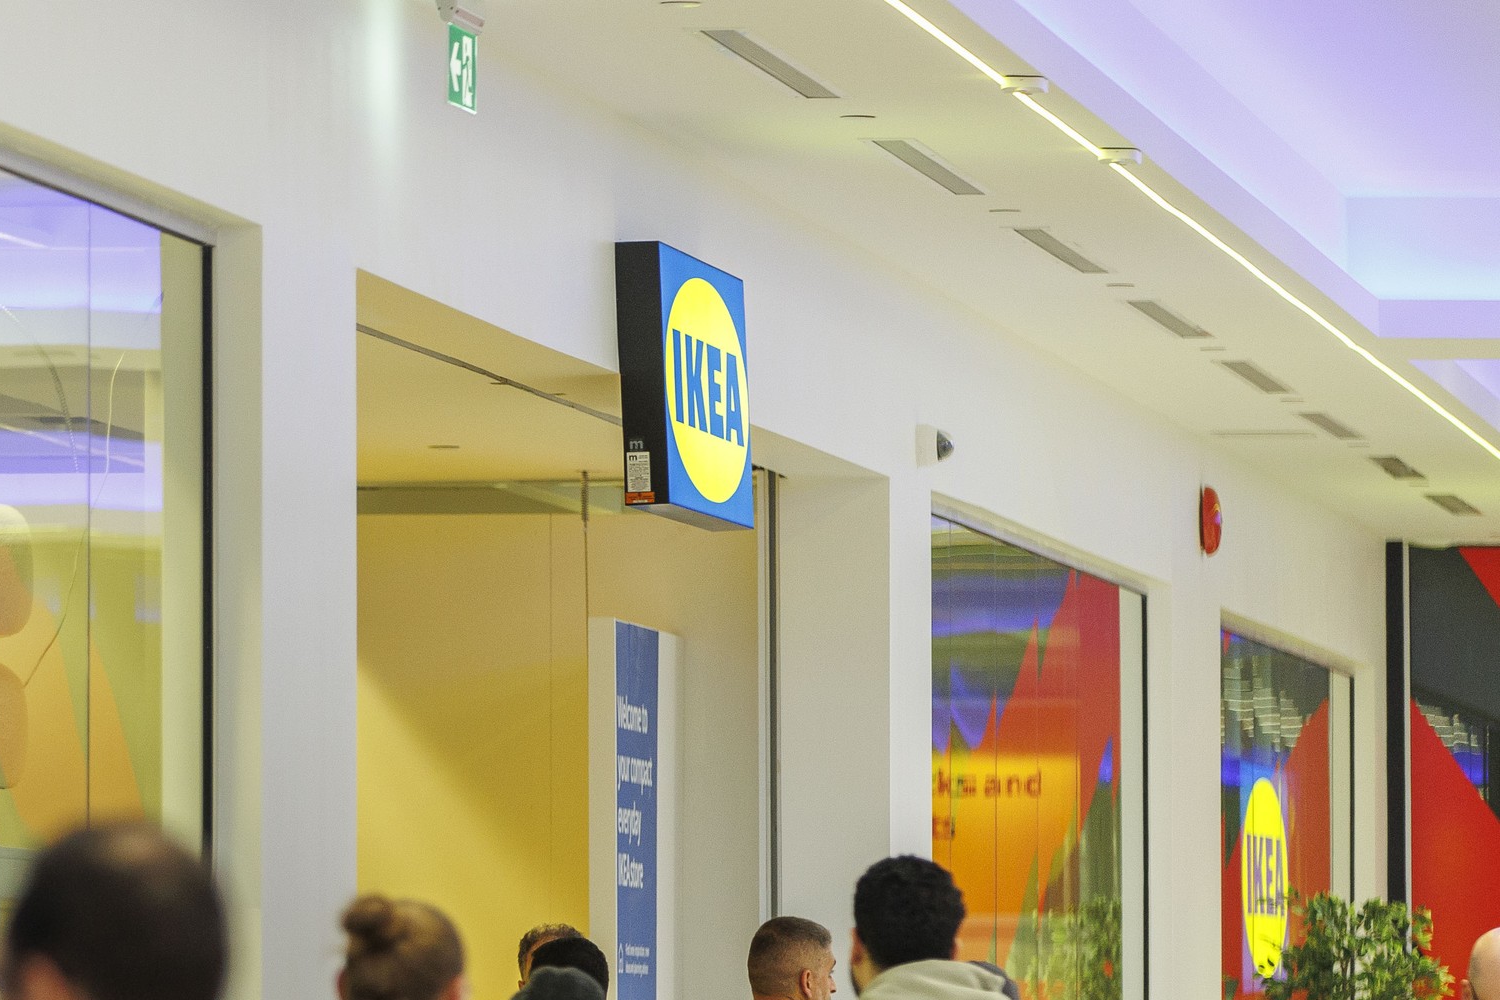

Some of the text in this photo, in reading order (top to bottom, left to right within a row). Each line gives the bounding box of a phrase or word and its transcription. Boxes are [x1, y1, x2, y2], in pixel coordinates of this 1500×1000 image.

[672, 328, 745, 448] IKEA
[618, 695, 648, 735] Welcome to
[618, 755, 653, 796] your compact
[984, 769, 1042, 799] and
[618, 801, 642, 847] everyday
[618, 853, 643, 890] IKEA store
[1247, 834, 1285, 917] IKEA
